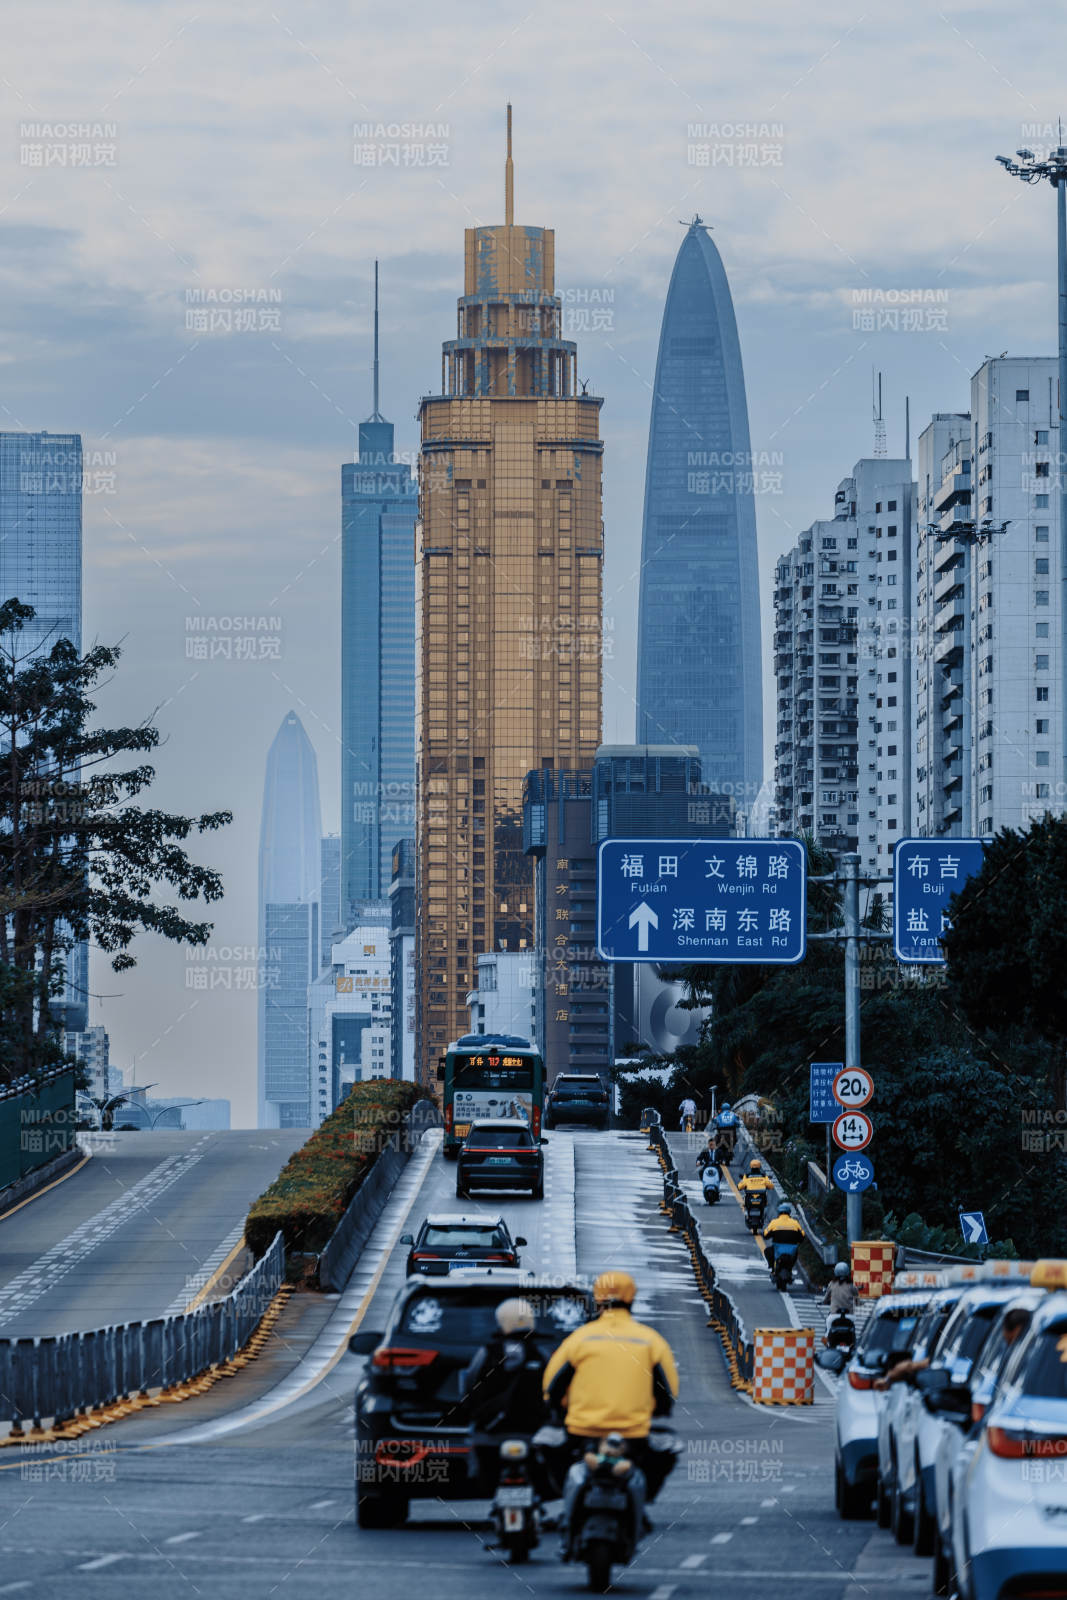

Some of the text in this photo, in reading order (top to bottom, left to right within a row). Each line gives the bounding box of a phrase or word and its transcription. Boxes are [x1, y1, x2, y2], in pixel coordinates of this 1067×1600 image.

[621, 853, 790, 879] 福田 文锦路
[907, 855, 960, 879] 布吉
[631, 882, 777, 895] Futian Wenjin Rd
[923, 883, 944, 895] Buji
[672, 907, 791, 932] 深南东路
[555, 858, 569, 1022] 南方联合大酒店
[677, 935, 788, 947] Shennan East Rd
[912, 936, 942, 946] Yant
